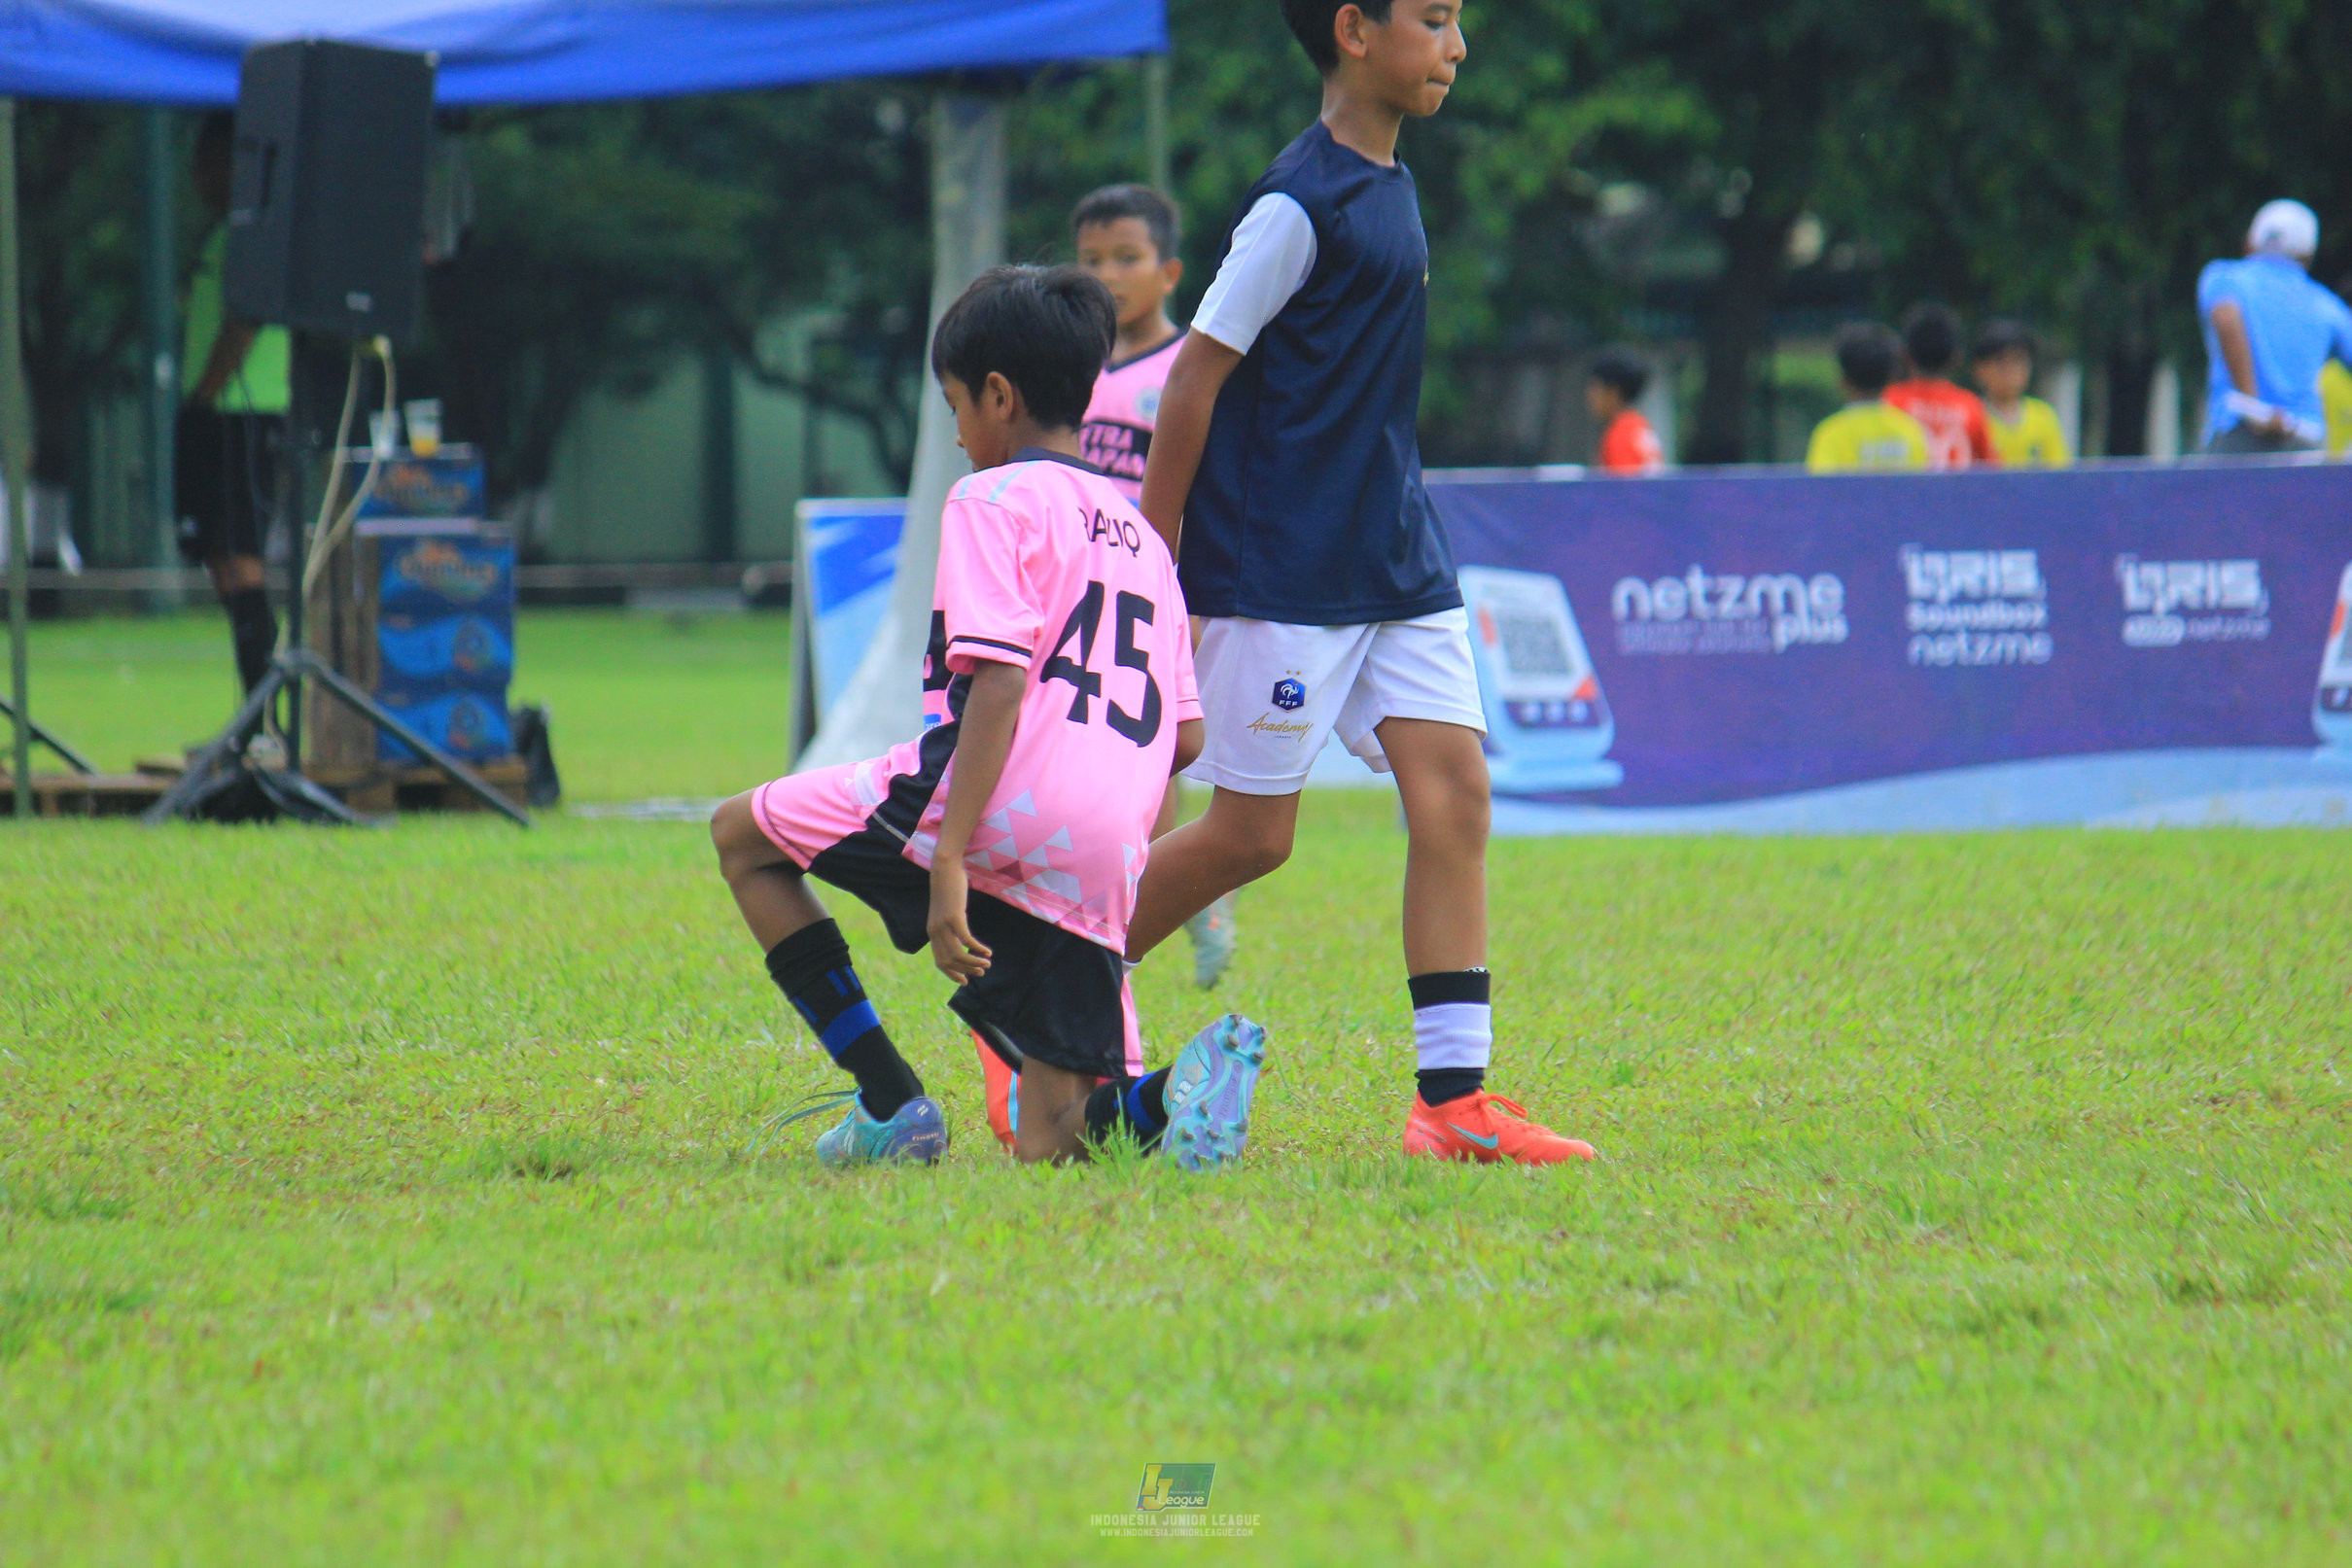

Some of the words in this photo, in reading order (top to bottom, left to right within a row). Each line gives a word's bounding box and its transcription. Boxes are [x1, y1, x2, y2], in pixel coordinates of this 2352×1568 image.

[1610, 563, 1844, 622] netzme
[1772, 611, 1849, 655] plus
[1907, 629, 2054, 666] netzme
[1039, 579, 1162, 748] 45
[1279, 699, 1298, 708] FFF
[1246, 712, 1314, 743] Academy
